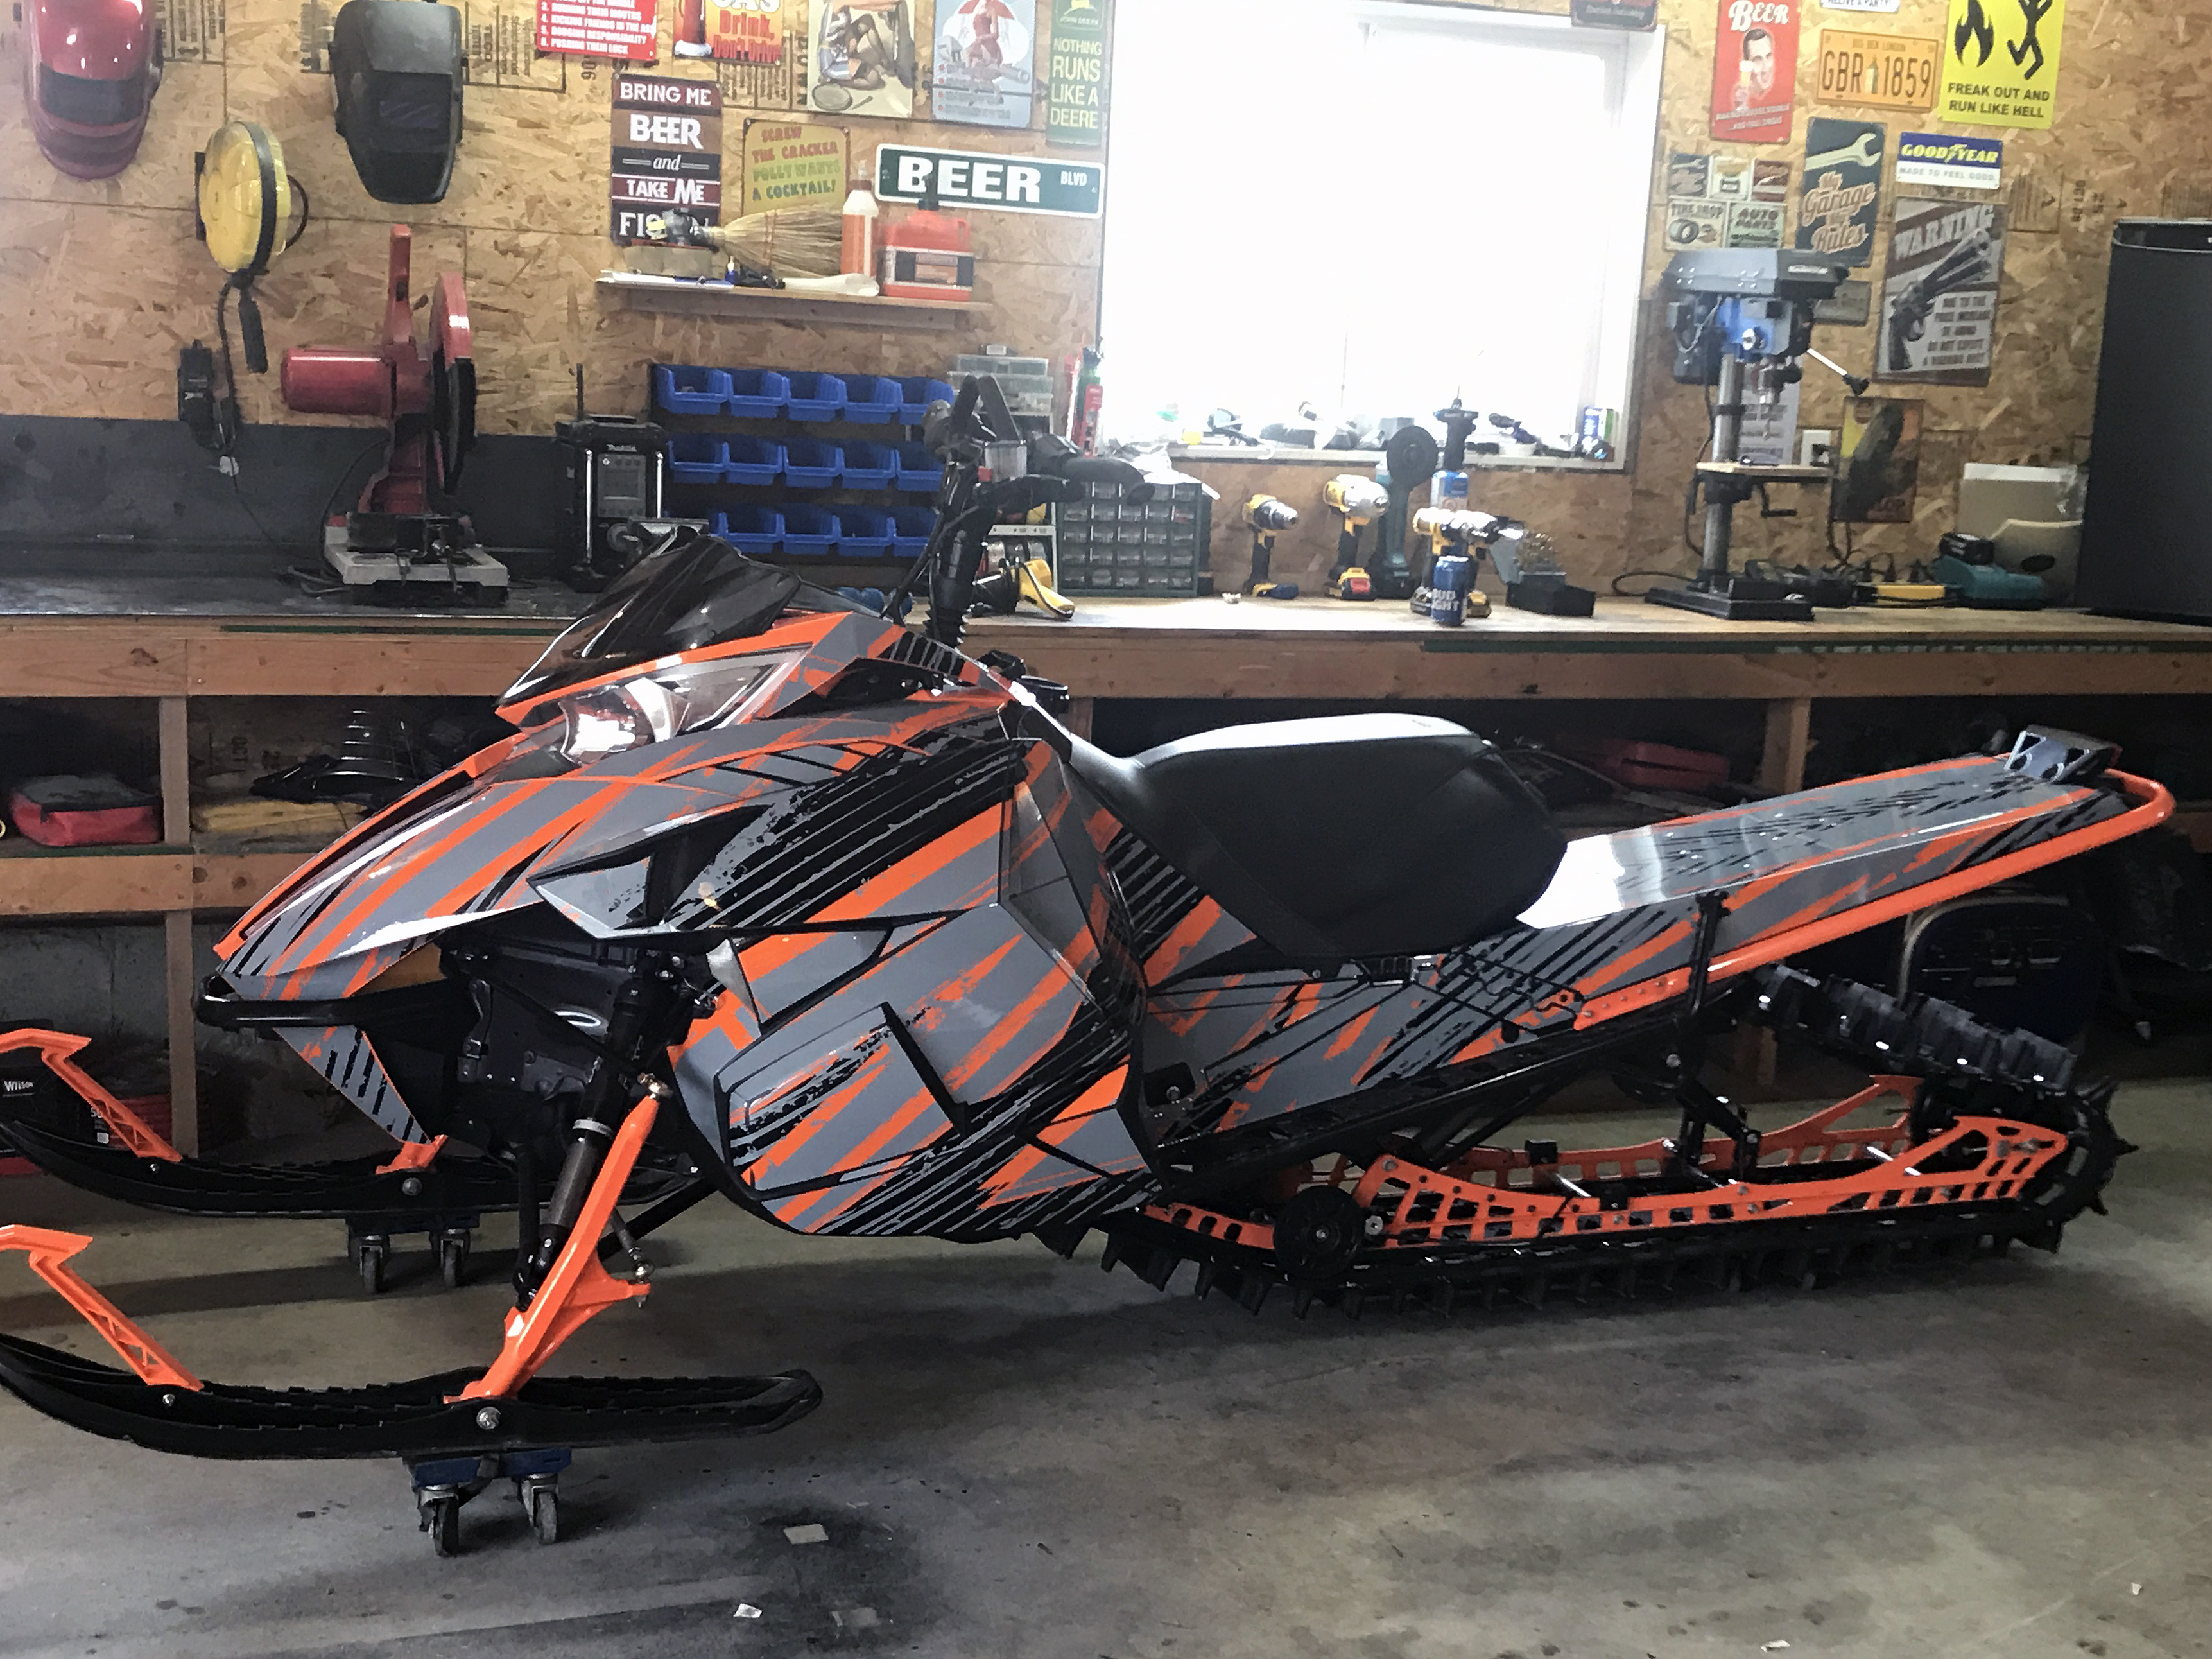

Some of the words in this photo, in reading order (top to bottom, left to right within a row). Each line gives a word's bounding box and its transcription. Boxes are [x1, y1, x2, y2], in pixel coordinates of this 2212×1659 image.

[1729, 0, 1788, 31] BEER
[1053, 37, 1102, 55] NOTHING
[1053, 55, 1100, 82] RUNS
[1822, 51, 1862, 93] GBR
[1884, 56, 1931, 98] 1859
[621, 82, 681, 103] BRING
[686, 88, 711, 105] ME
[1051, 83, 1085, 105] LIKE
[1088, 86, 1098, 106] A
[1948, 82, 1989, 96] FREAK
[1994, 87, 2020, 99] OUT
[2023, 90, 2050, 101] AND
[1050, 107, 1098, 128] DEERE
[1949, 100, 1976, 112] RUN
[1980, 103, 2009, 115] LIKE
[2013, 105, 2044, 117] HELL
[630, 114, 704, 149] BEER
[761, 126, 802, 143] SCREW
[653, 155, 681, 171] and
[752, 148, 775, 163] THE
[782, 141, 838, 159] CRACKER
[1901, 143, 1998, 163] GOODYEAR
[898, 155, 1041, 203] BEER
[1060, 171, 1087, 186] BLVD
[1899, 167, 1924, 175] MADE
[1943, 170, 1964, 179] FEEL
[626, 180, 668, 198] TAKE
[674, 179, 705, 204] ME
[753, 188, 761, 201] A
[766, 179, 836, 199] COCKTAIL!
[1738, 207, 1779, 220] AUTO
[1804, 184, 1874, 222] Garage
[1814, 225, 1864, 251] Rules
[1895, 205, 1994, 261] WARNING
